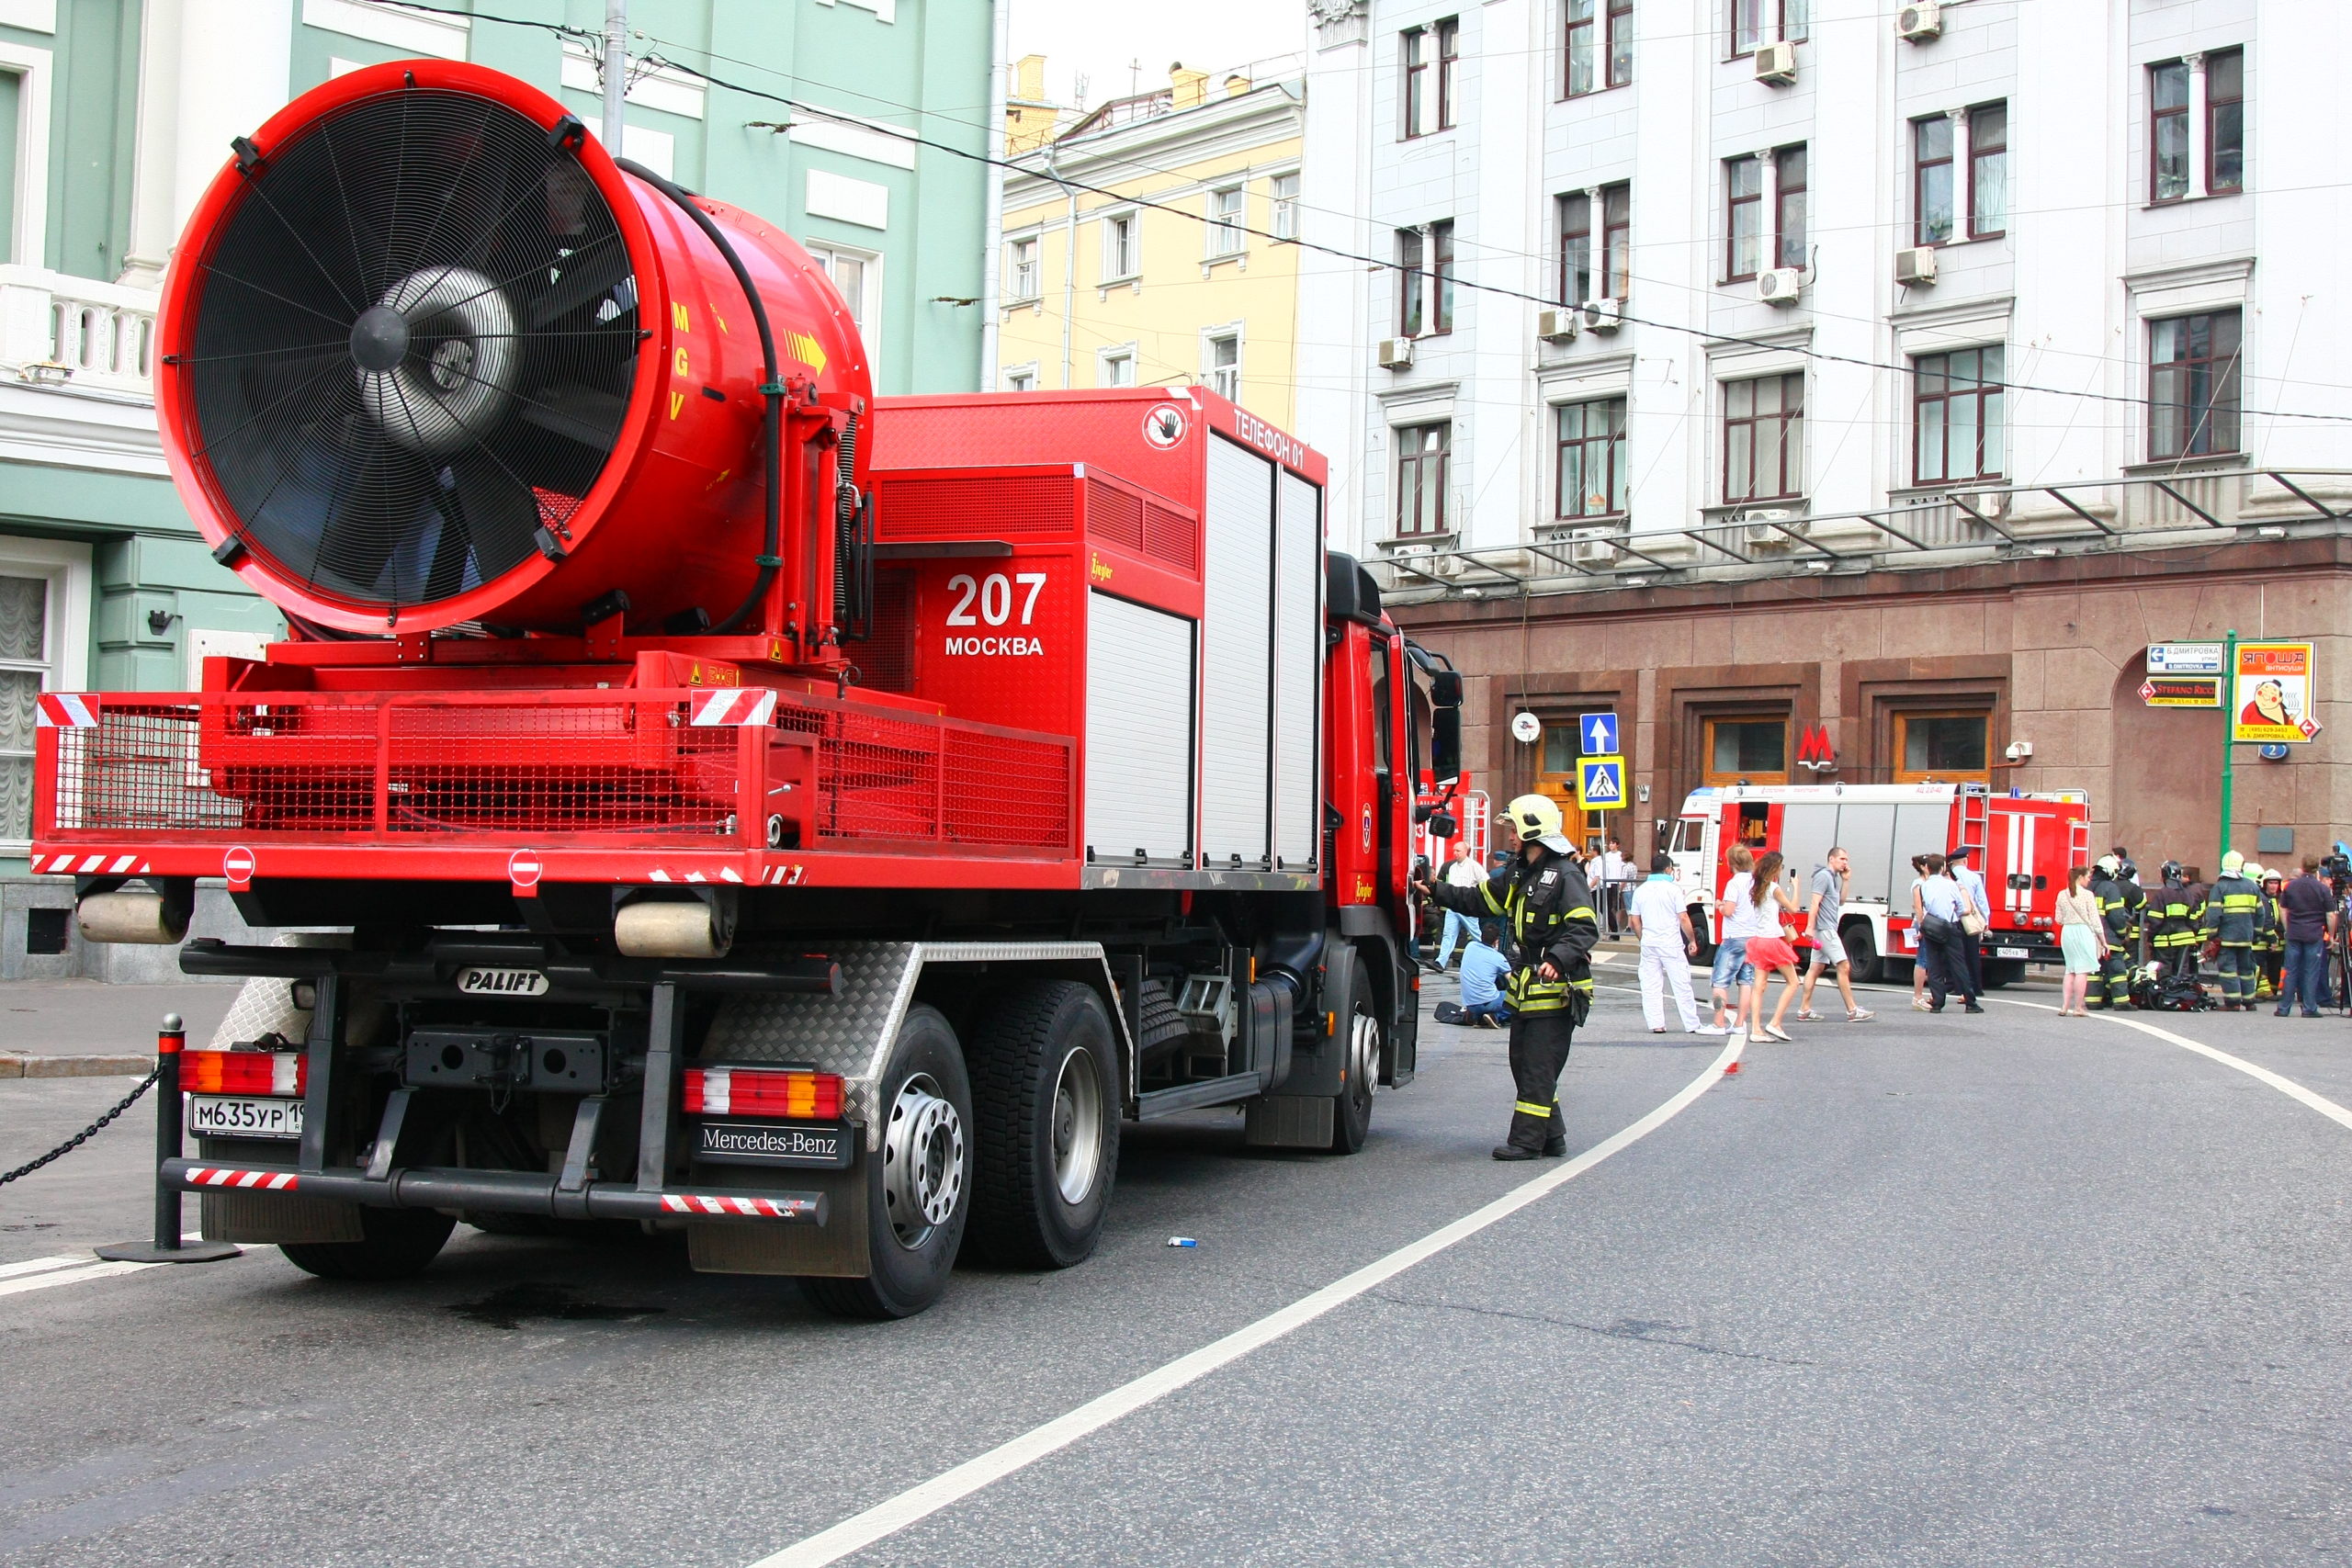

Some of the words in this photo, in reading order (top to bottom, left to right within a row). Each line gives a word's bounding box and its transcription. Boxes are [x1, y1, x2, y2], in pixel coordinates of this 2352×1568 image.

[1234, 408, 1290, 462] ТЕЛЕФОН
[1292, 443, 1304, 470] 01
[1091, 552, 1114, 581] Ziegler
[945, 572, 1046, 626] 207
[945, 637, 1044, 656] МОСКВА
[2268, 745, 2277, 755] 2
[1540, 870, 1558, 885] 207
[465, 971, 541, 992] PALIFT
[702, 1128, 837, 1154] Mercedes-Benz
